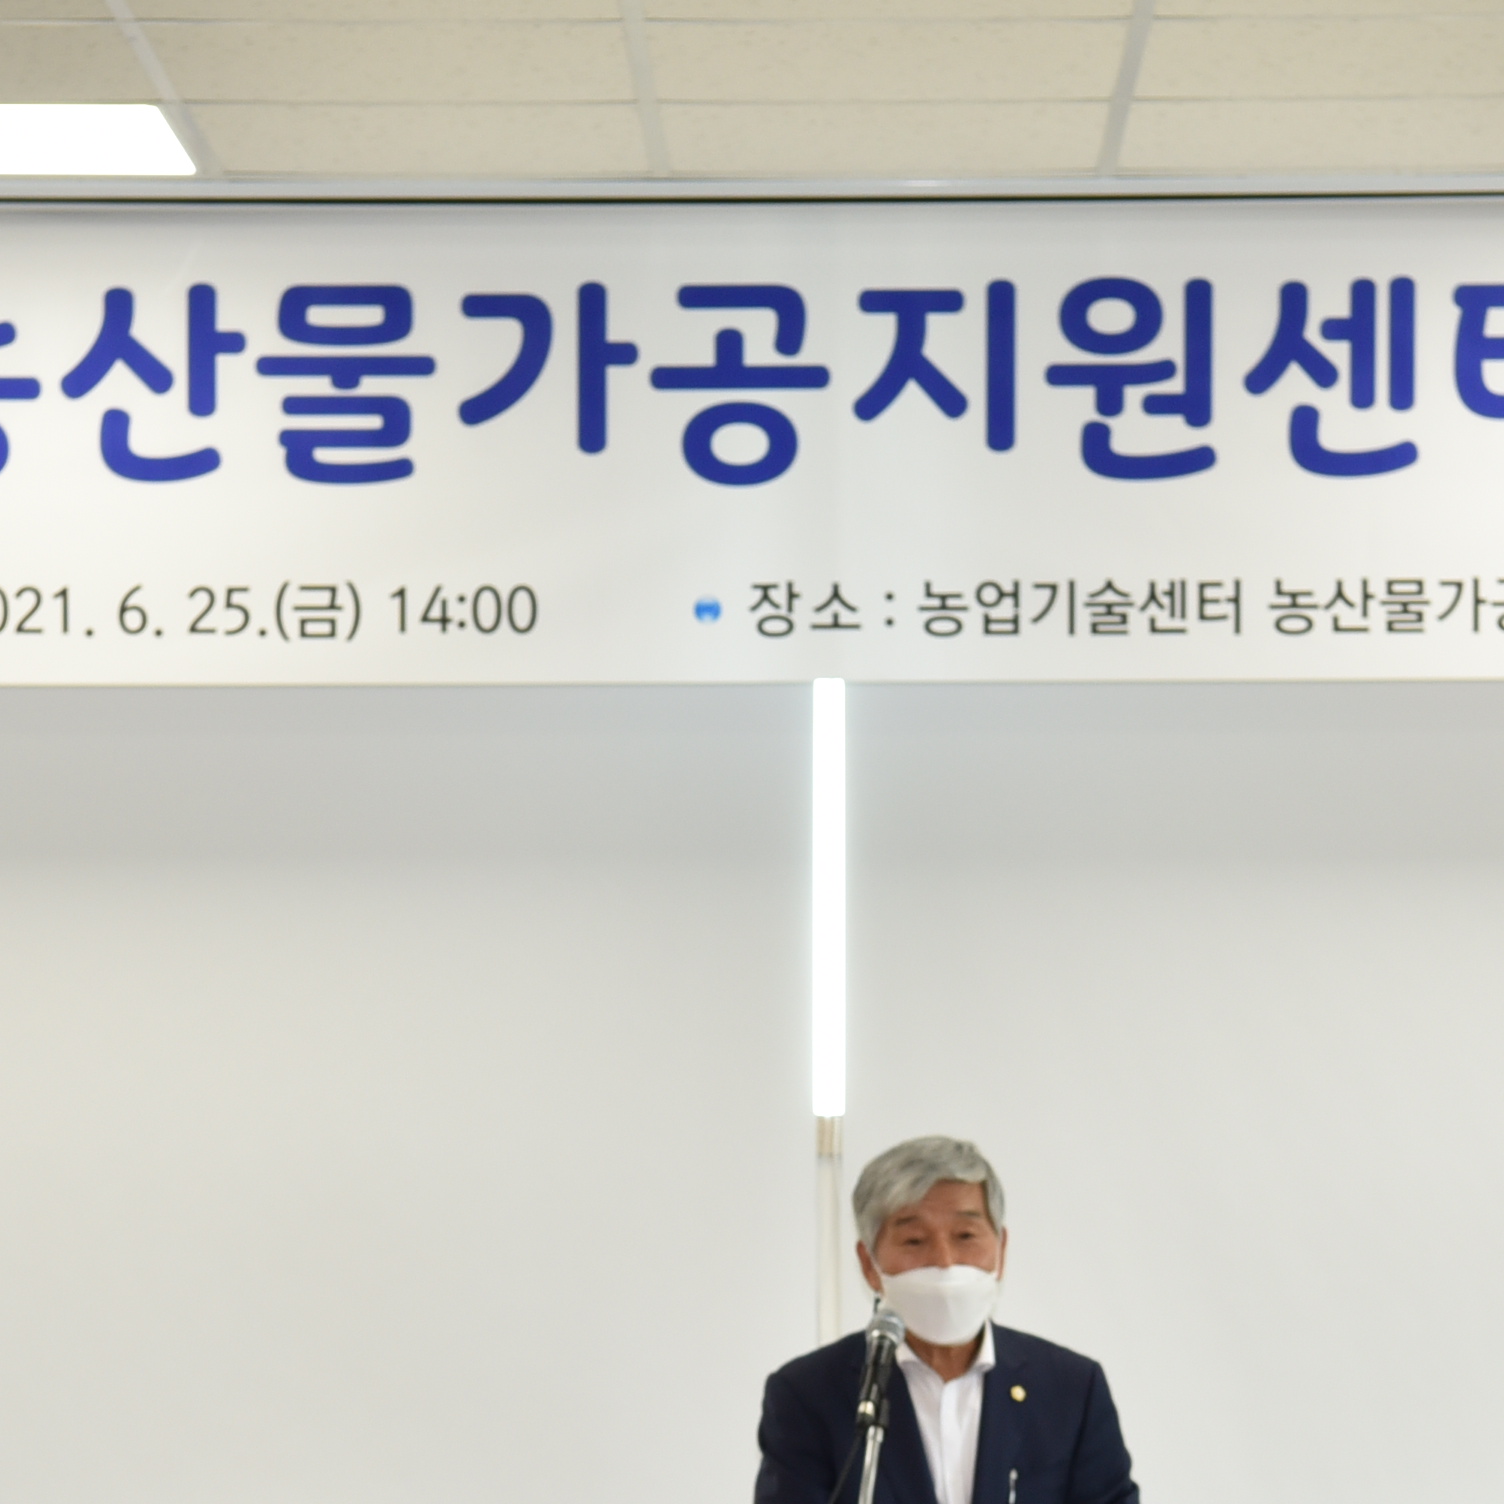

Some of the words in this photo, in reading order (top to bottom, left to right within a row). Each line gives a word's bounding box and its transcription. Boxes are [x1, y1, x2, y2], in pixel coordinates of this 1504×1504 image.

[117, 585, 165, 639] 6.
[187, 582, 363, 642] 25.(금)
[390, 583, 540, 637] 14:00
[749, 580, 863, 640] 장소
[918, 578, 1244, 640] 농업기술센터
